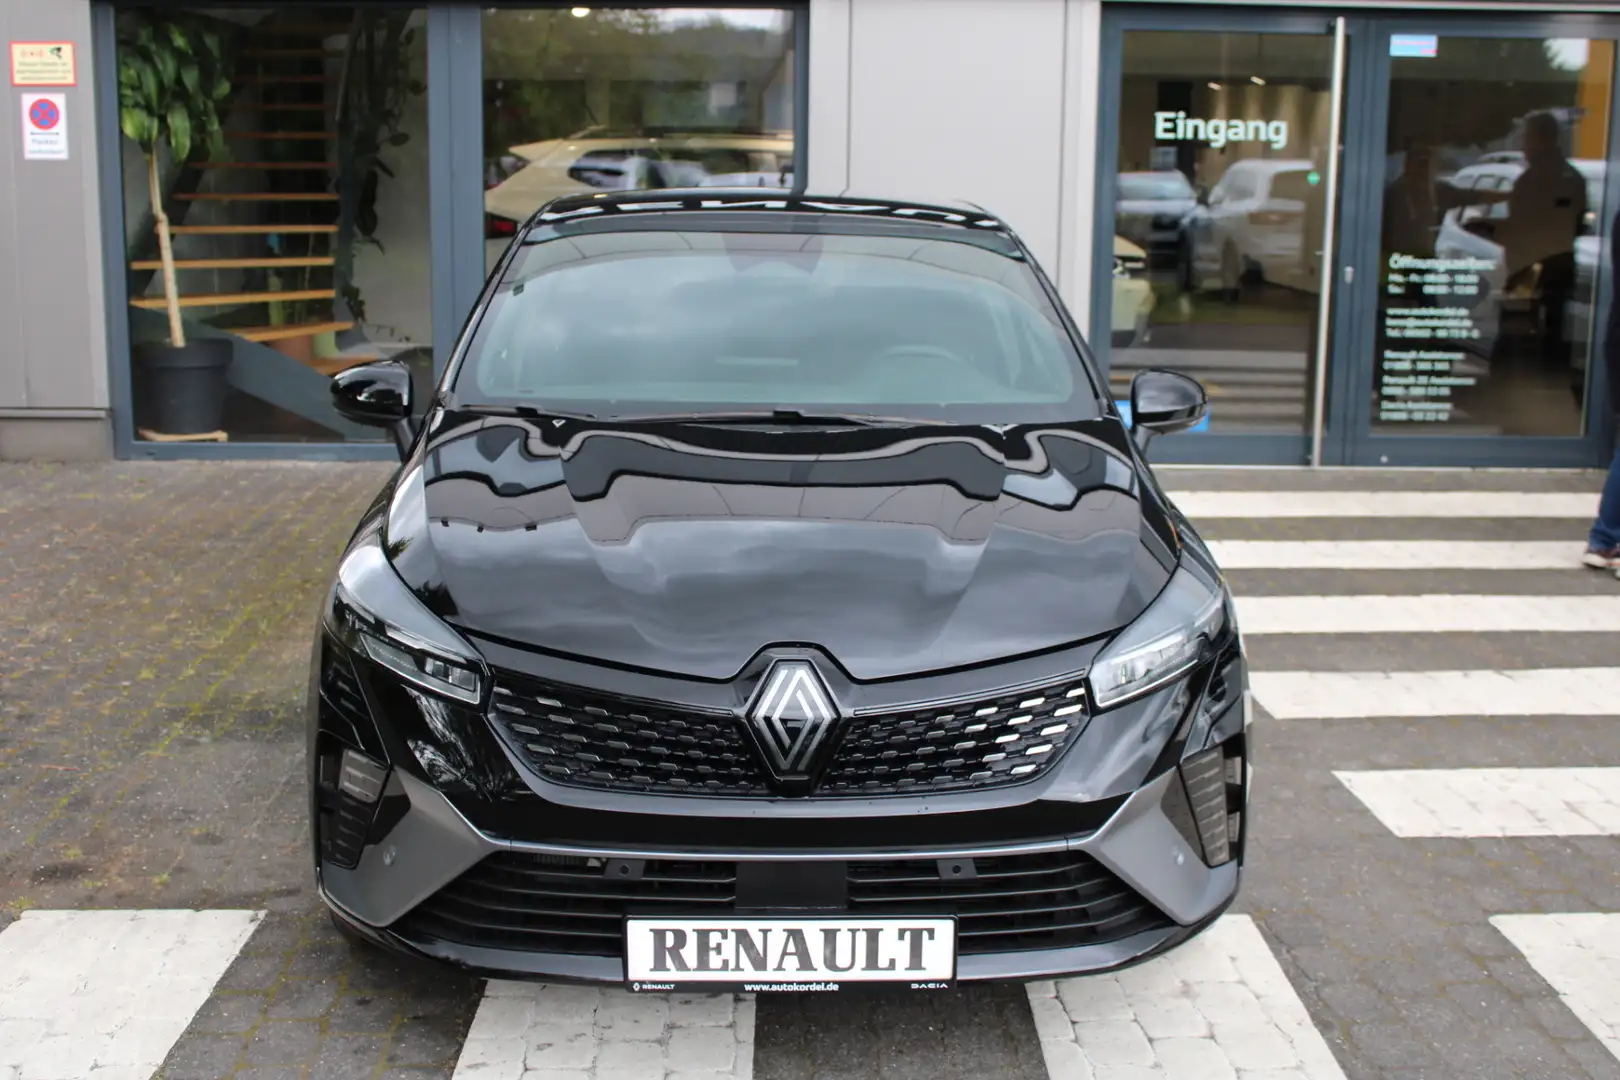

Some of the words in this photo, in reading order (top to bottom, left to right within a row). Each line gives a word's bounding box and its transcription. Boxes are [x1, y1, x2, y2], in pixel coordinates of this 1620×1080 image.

[1155, 110, 1288, 149] Eingang
[649, 928, 935, 972] RENAULT
[744, 983, 840, 992] www.autokordel.de
